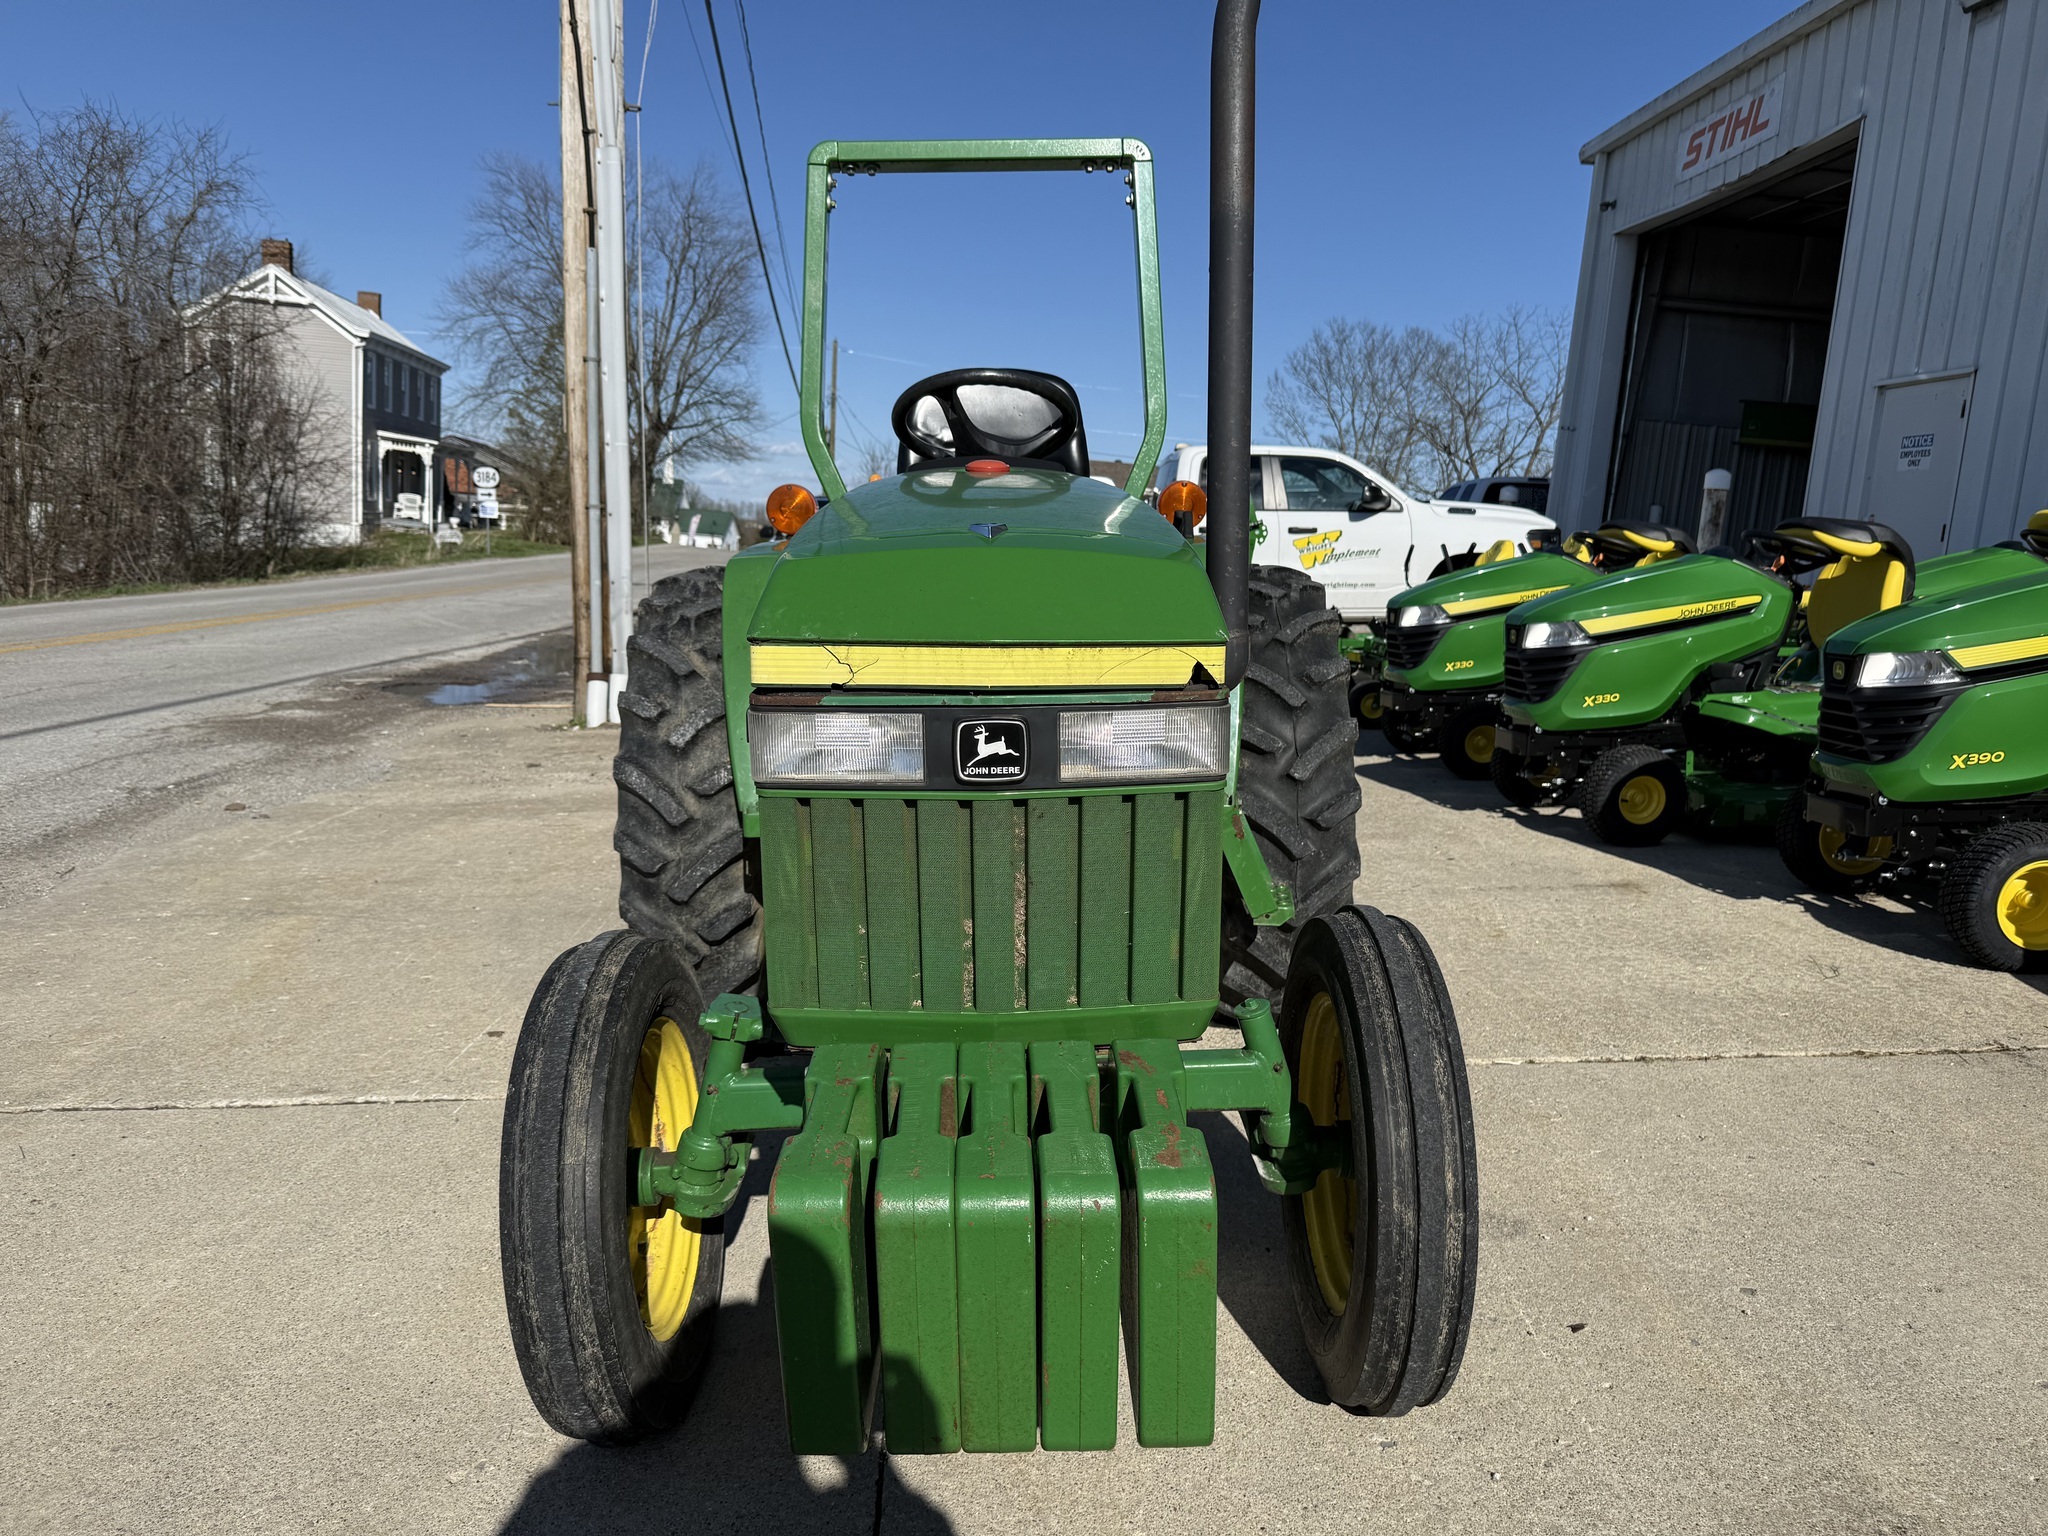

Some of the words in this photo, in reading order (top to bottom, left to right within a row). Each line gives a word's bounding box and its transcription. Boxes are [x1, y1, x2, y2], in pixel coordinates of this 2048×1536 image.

[1682, 94, 1770, 172] STIHL
[1902, 435, 1933, 448] NOTICE
[1900, 449, 1931, 459] EMPLOYEES
[1907, 459, 1921, 467] ONLY
[476, 471, 497, 483] 3184
[1299, 543, 1334, 554] WRIGHT
[1321, 548, 1381, 564] Implement
[1677, 607, 1704, 619] JOHN
[1706, 600, 1737, 614] DEERE
[1445, 660, 1474, 672] X330
[1582, 693, 1620, 708] X330
[1948, 751, 2005, 770] X390
[963, 767, 989, 775] JOHN
[990, 766, 1021, 774] DEERE
